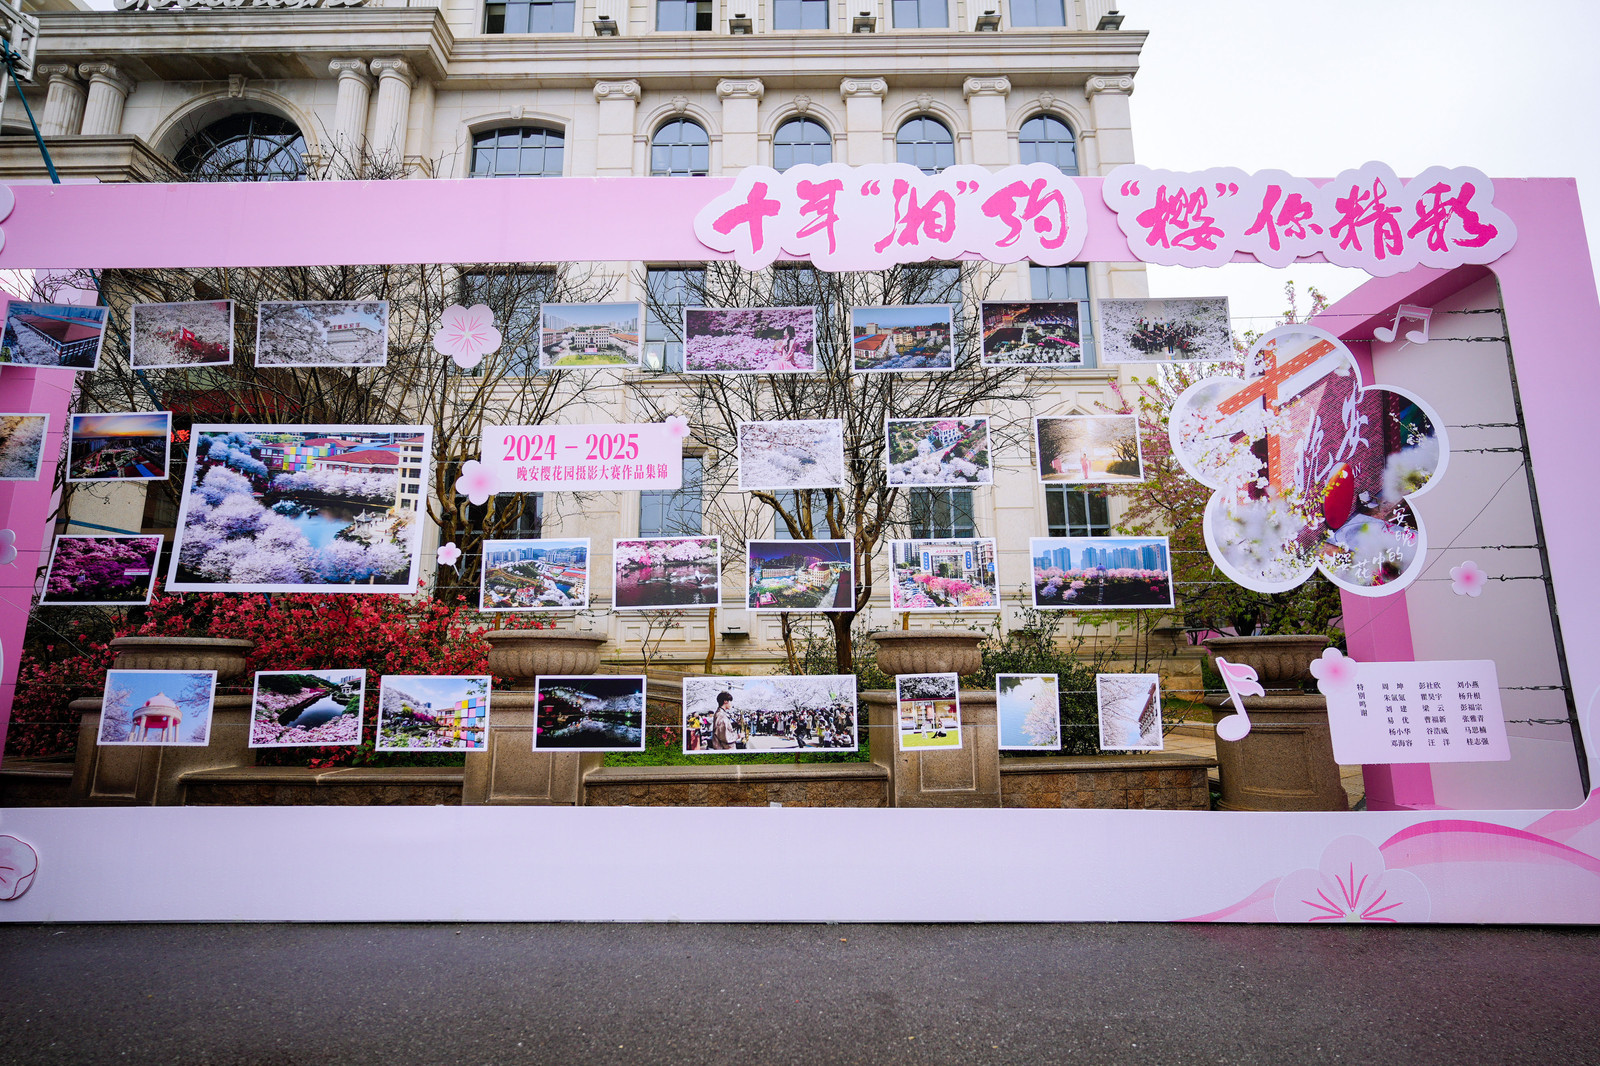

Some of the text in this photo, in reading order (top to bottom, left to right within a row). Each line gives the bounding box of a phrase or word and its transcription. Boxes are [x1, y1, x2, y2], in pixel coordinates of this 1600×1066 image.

[503, 434, 557, 461] 2024
[585, 433, 639, 460] 2025
[516, 463, 668, 482] 晚安樱花园摄影大赛作品集锦
